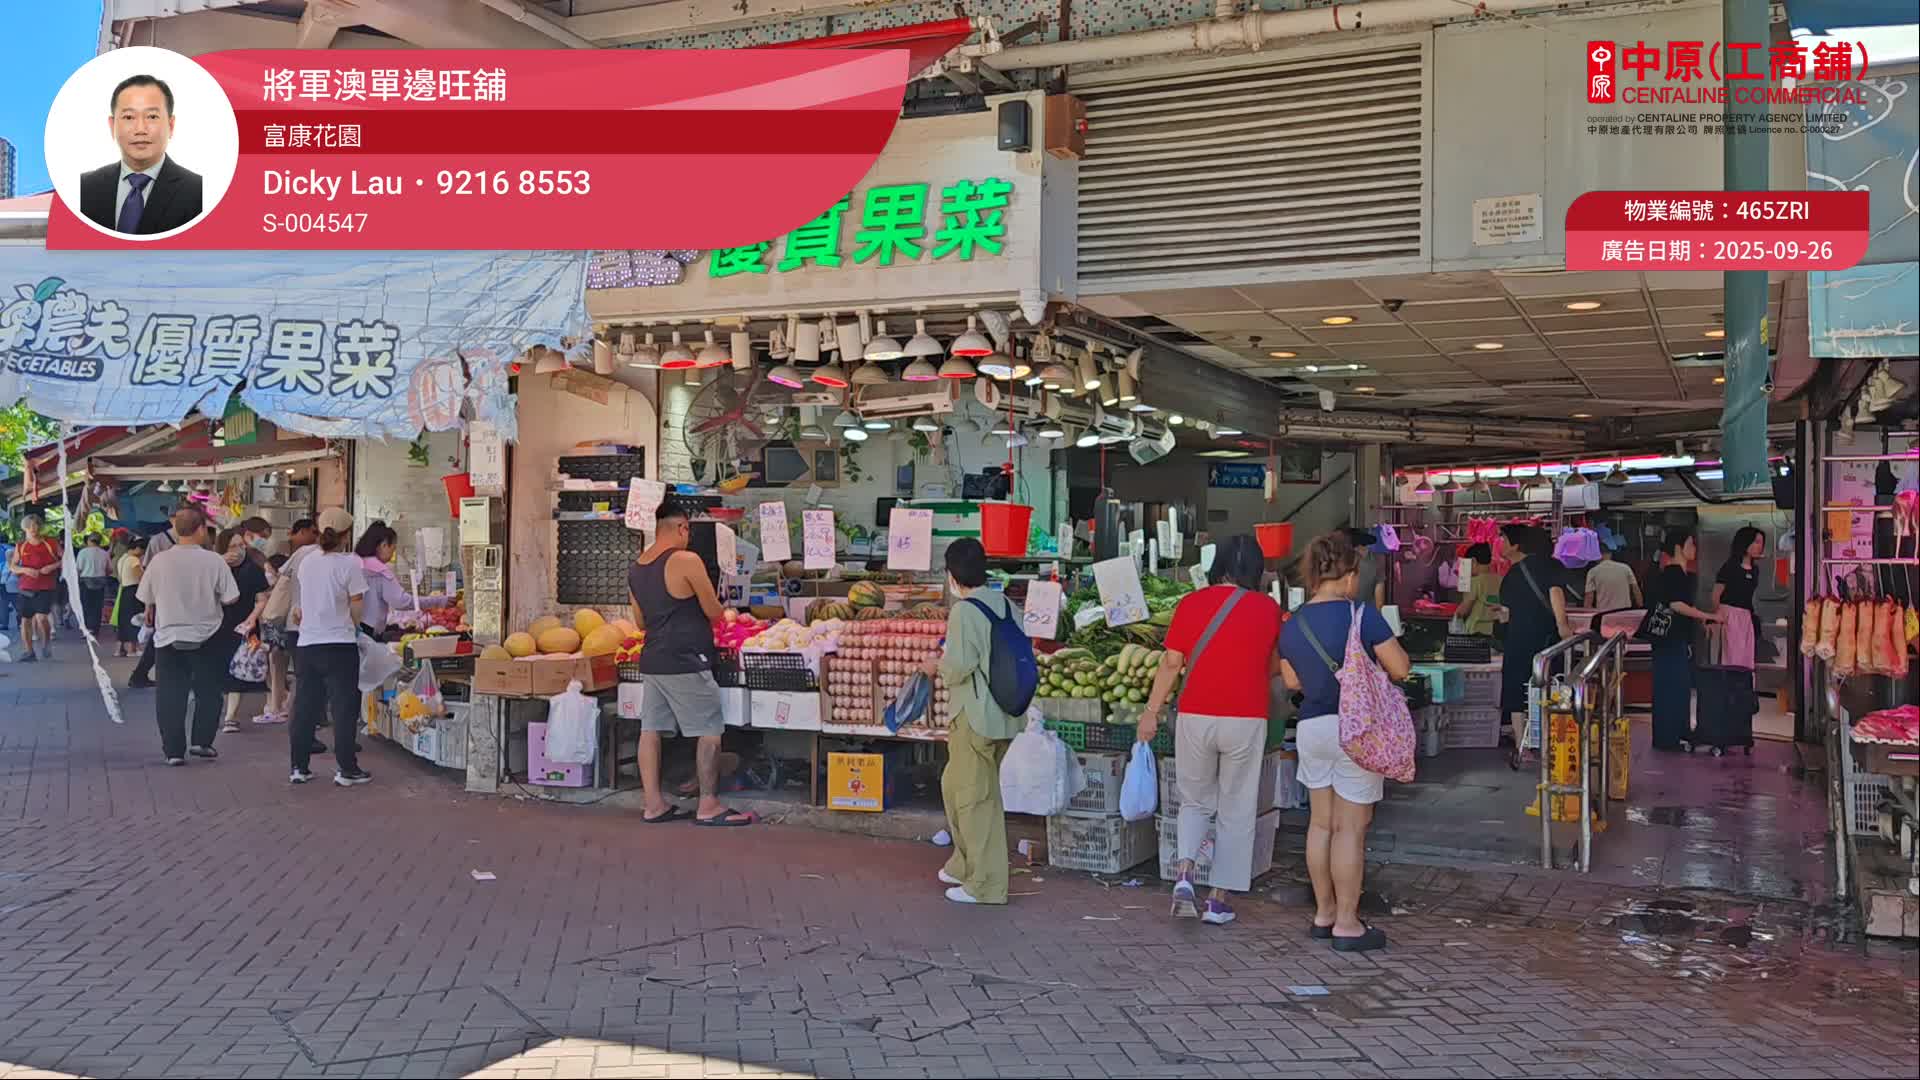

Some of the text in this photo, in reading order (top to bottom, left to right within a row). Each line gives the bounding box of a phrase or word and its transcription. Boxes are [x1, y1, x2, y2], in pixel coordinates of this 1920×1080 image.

[0, 352, 97, 378] EGETABLES
[131, 313, 399, 399] 優質果菜
